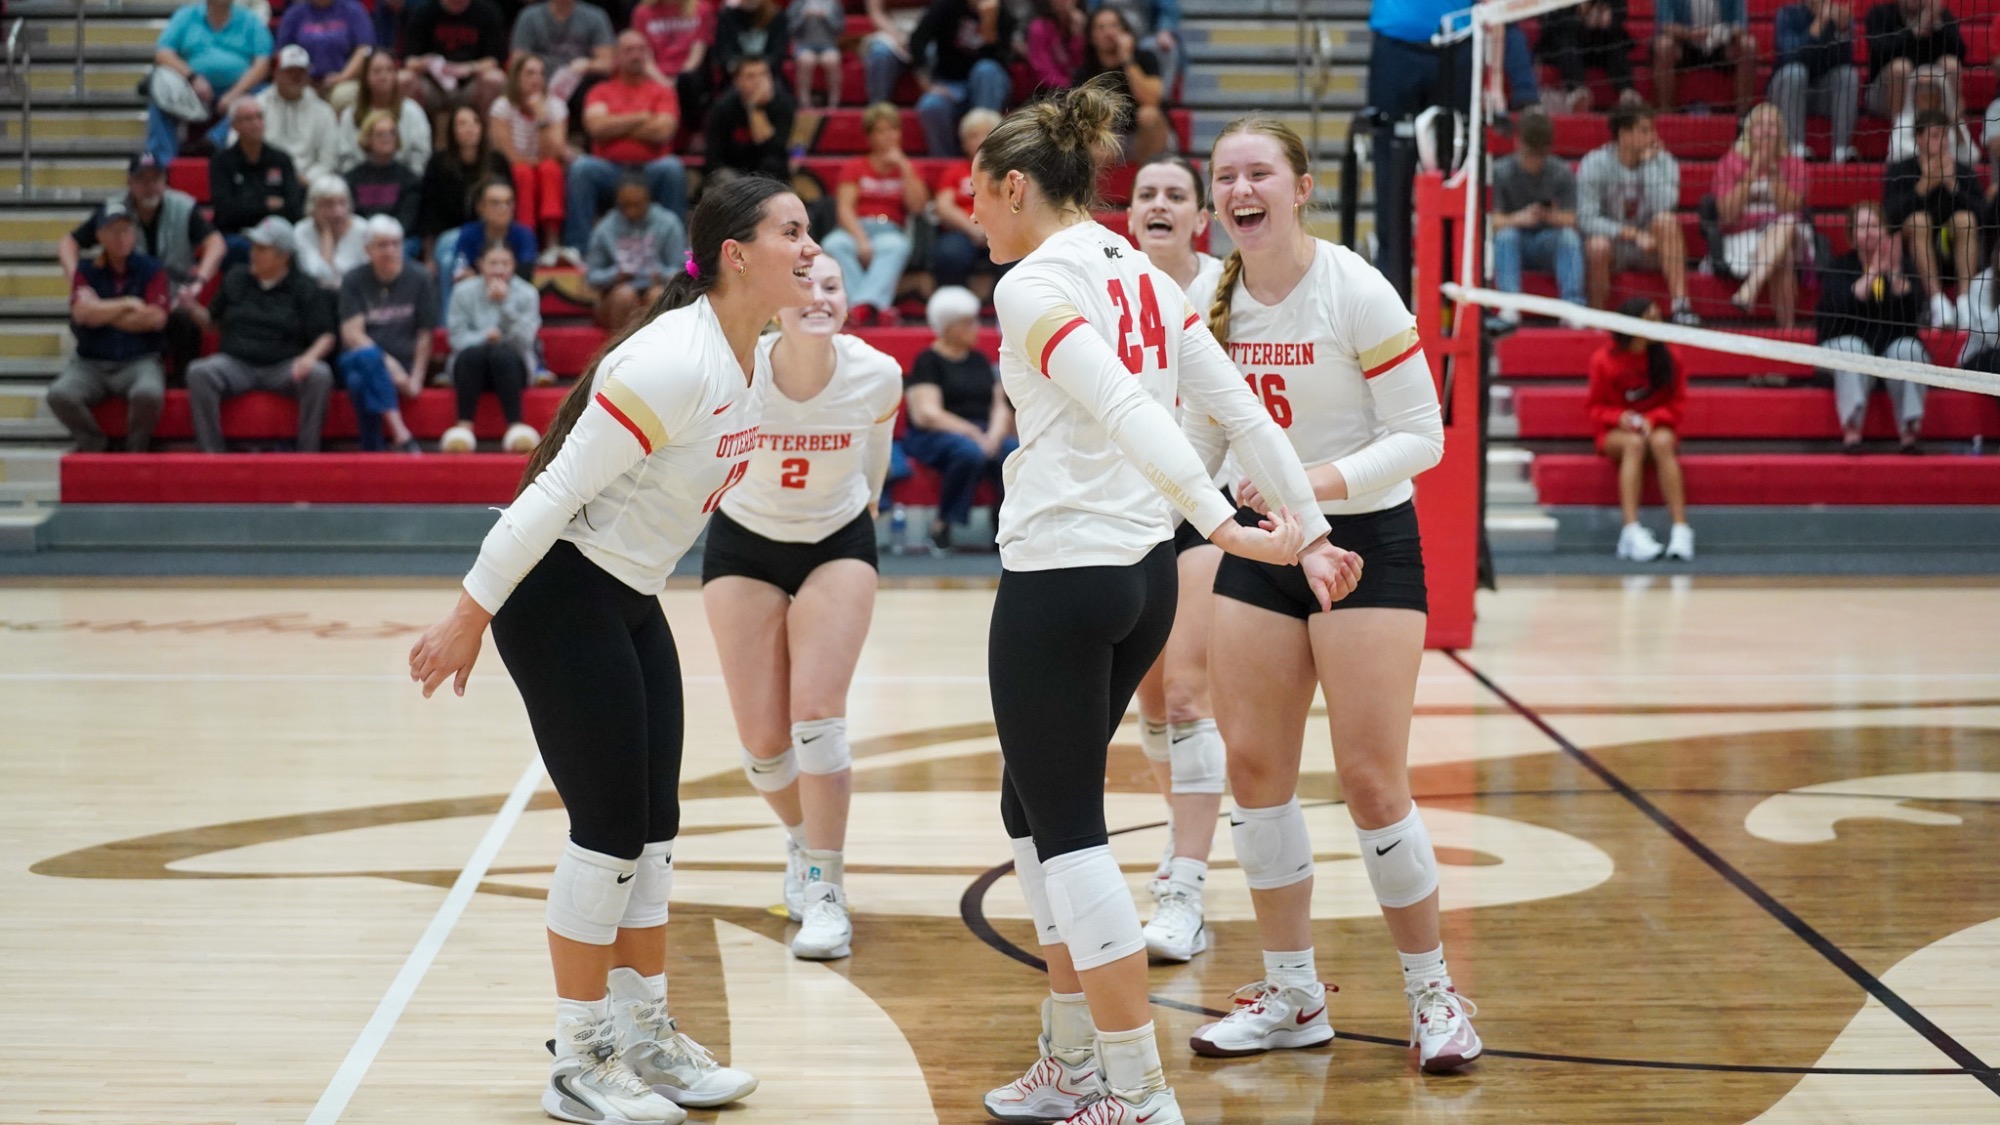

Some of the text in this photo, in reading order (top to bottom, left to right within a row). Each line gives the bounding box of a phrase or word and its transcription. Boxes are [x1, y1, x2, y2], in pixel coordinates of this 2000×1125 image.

[1107, 273, 1167, 375] 24
[1224, 342, 1314, 366] TTERBEIN
[757, 433, 851, 451] TTERBEIN
[702, 460, 749, 514] 17
[781, 458, 810, 489] 2
[1144, 462, 1199, 513] CARDINALS
